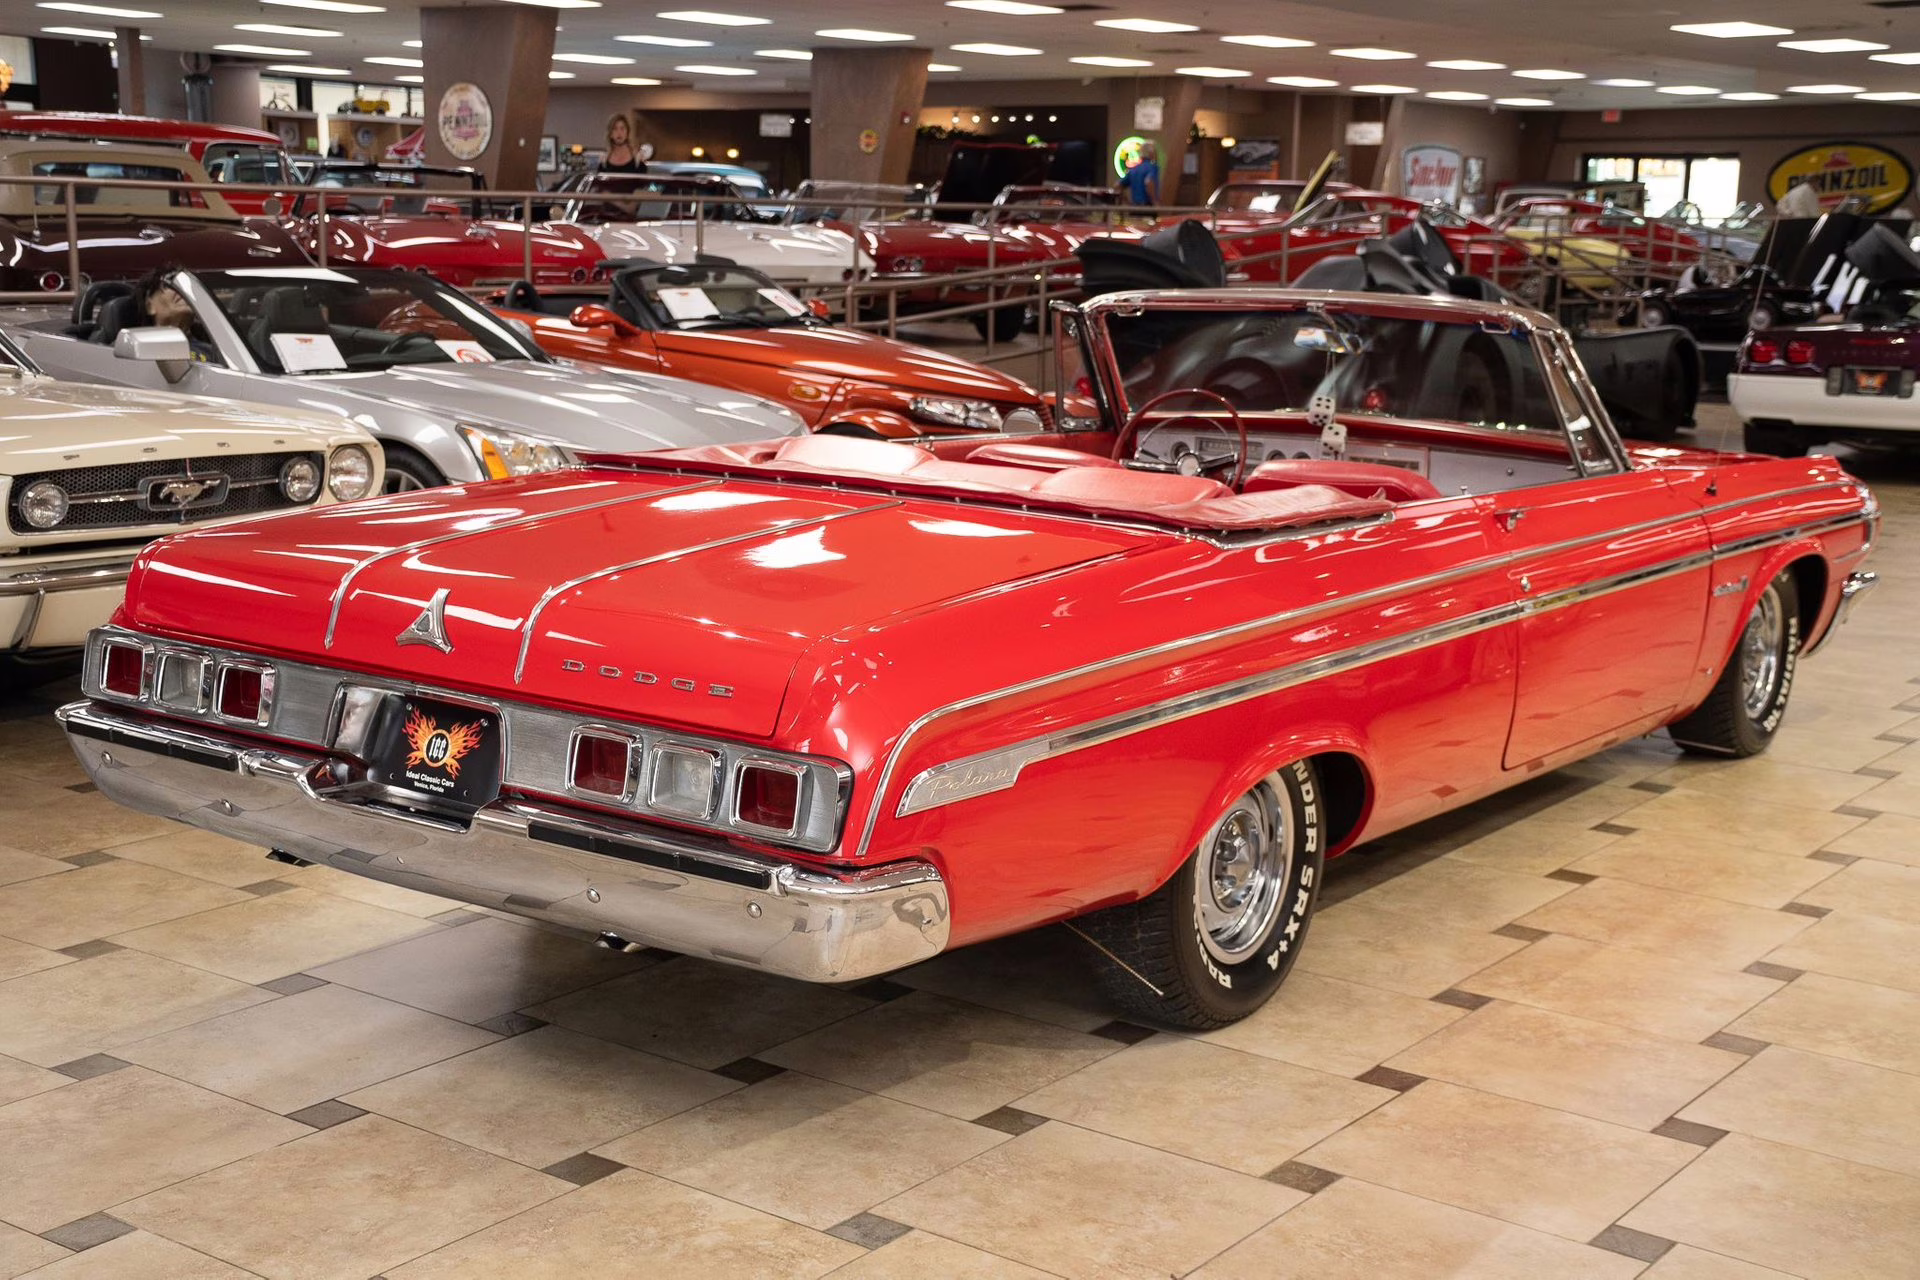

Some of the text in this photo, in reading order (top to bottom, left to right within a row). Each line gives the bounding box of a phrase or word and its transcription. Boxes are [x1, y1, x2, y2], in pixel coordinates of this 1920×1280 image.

[1787, 163, 1889, 194] PNNZOIL
[562, 659, 735, 698] DODGE
[405, 770, 455, 788] Ideal Classic Cars
[429, 784, 445, 793] Florida
[926, 766, 1011, 800] Polara
[1292, 759, 1317, 853] NDER
